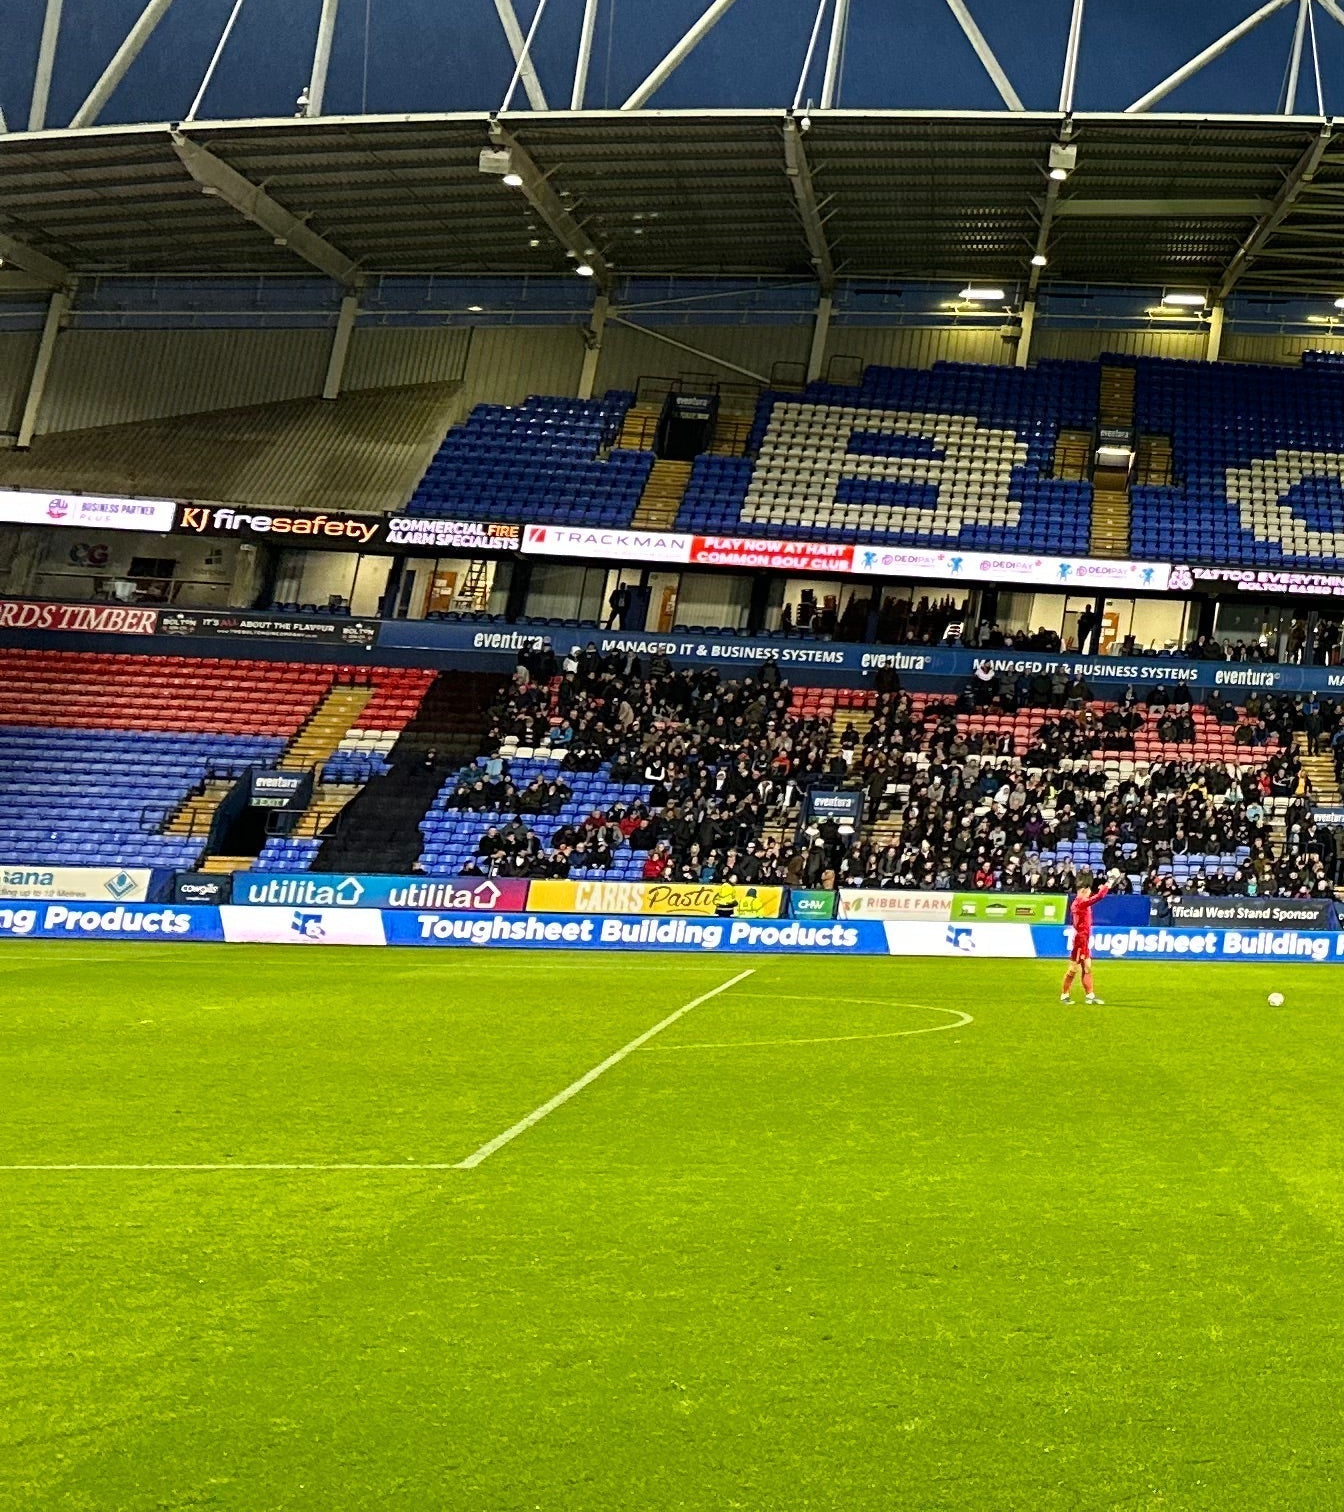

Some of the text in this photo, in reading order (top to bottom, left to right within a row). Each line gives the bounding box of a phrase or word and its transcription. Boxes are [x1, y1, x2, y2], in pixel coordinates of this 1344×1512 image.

[180, 507, 379, 543] KJ firesafety
[389, 518, 519, 538] COMMERCIAL FIRE
[386, 531, 519, 550] ALARM SPECIALISTS
[554, 531, 685, 549] TRACKMAN
[704, 538, 846, 557] PLAY NOW AT HART
[697, 552, 849, 570] COMMON GOLF CLUB
[1192, 568, 1255, 582] TATTOO
[58, 605, 156, 634] TIMBER
[203, 618, 335, 633] IT'S ABOUT THE FLAVOUR
[473, 631, 543, 650] eventura
[601, 639, 844, 664] MANAGED IT & BUSINESS SYSTEMS
[1045, 660, 1059, 675] IT
[1061, 663, 1072, 675] &
[1074, 662, 1138, 678] BUSINESS
[1139, 666, 1198, 682] SYSTEMS
[1215, 668, 1275, 687] eventura
[249, 879, 333, 905] utilita
[389, 883, 472, 908] utilita
[575, 883, 644, 912] CARRS
[867, 898, 952, 910] RIBBLE FARM
[43, 906, 192, 933] Products
[1205, 907, 1319, 922] West Stand Sponsor
[417, 915, 859, 947] Toughsheet Building Products
[1223, 931, 1329, 959] Building
